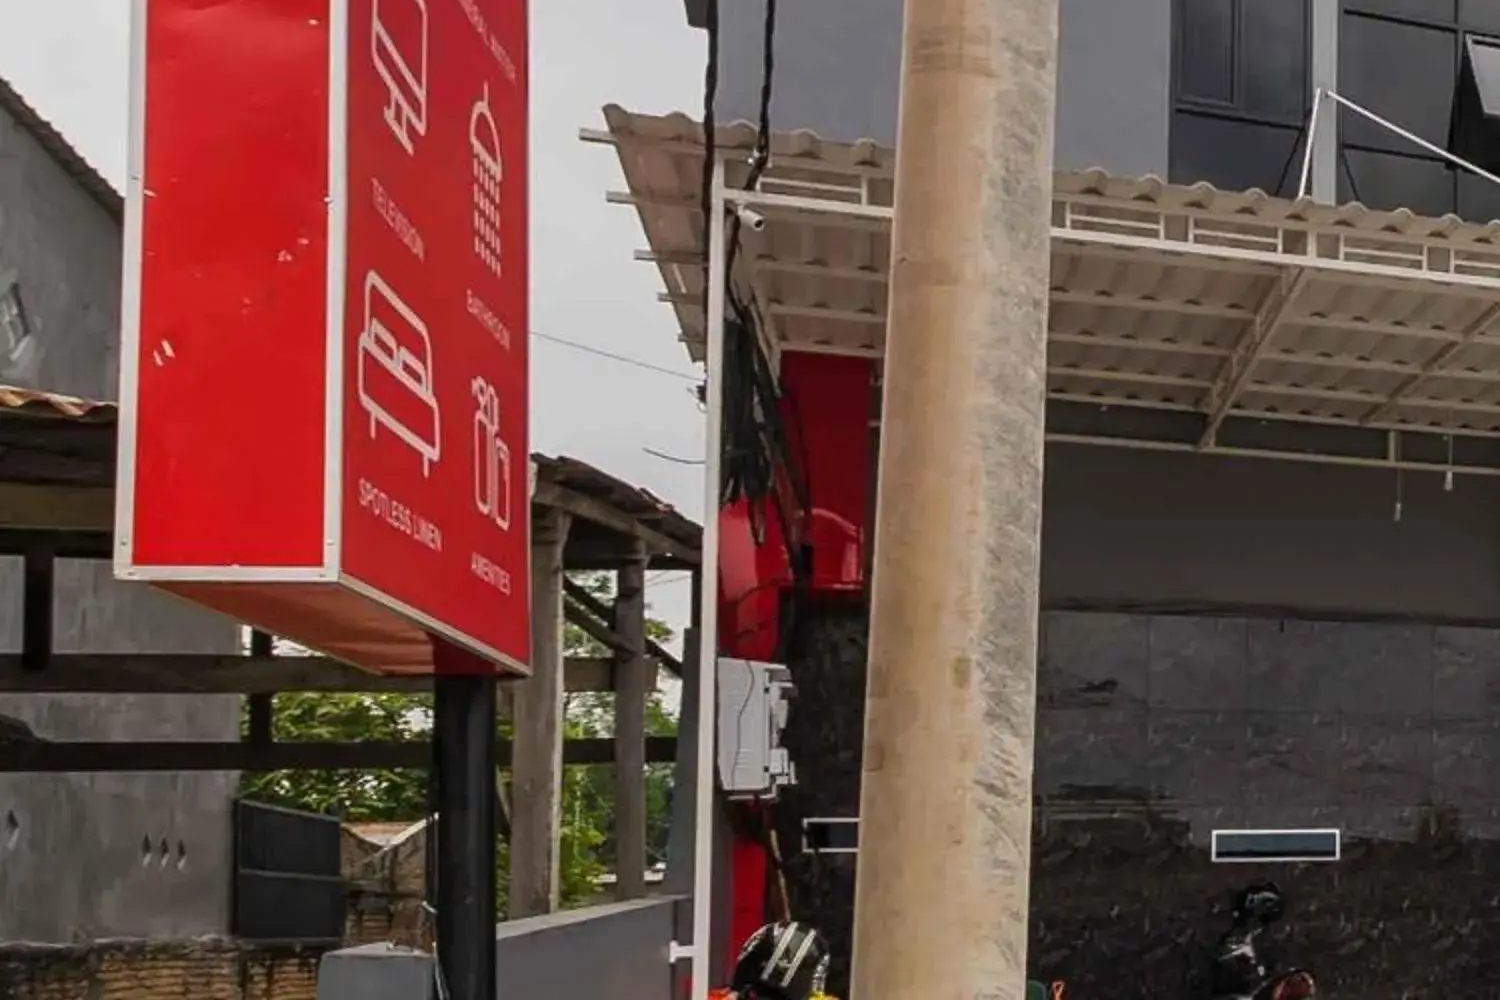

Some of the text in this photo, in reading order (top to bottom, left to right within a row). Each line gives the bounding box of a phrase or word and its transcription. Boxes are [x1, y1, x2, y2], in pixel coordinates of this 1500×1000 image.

[371, 176, 424, 264] TELEVISION
[359, 477, 443, 552] SPOTLESS LINEN
